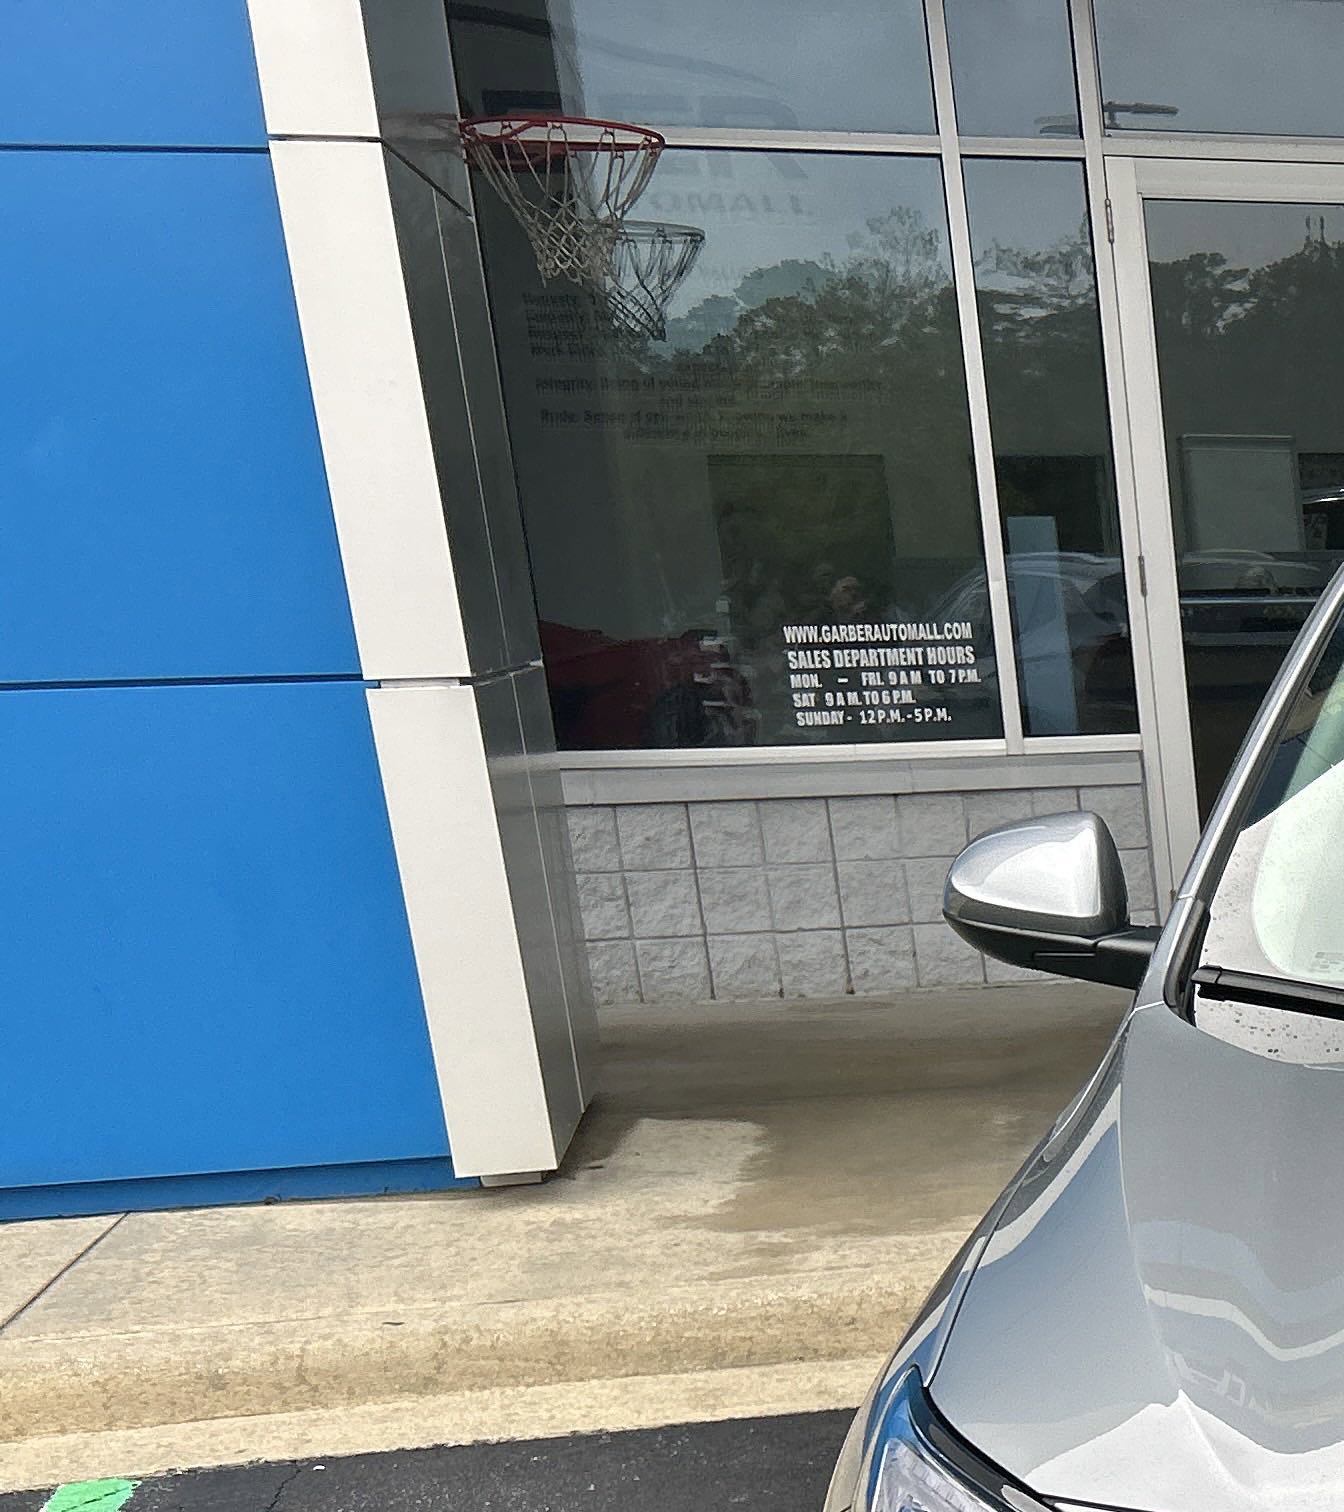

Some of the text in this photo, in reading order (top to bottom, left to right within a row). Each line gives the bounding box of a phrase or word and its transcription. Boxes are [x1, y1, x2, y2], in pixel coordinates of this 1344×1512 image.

[783, 622, 973, 643] WWW.GARBERAUTOMALL.COM
[787, 645, 976, 670] SALES DEPARTMENT HOURS
[789, 673, 823, 689] MON.
[927, 669, 946, 684] TO
[792, 692, 816, 708] SAT
